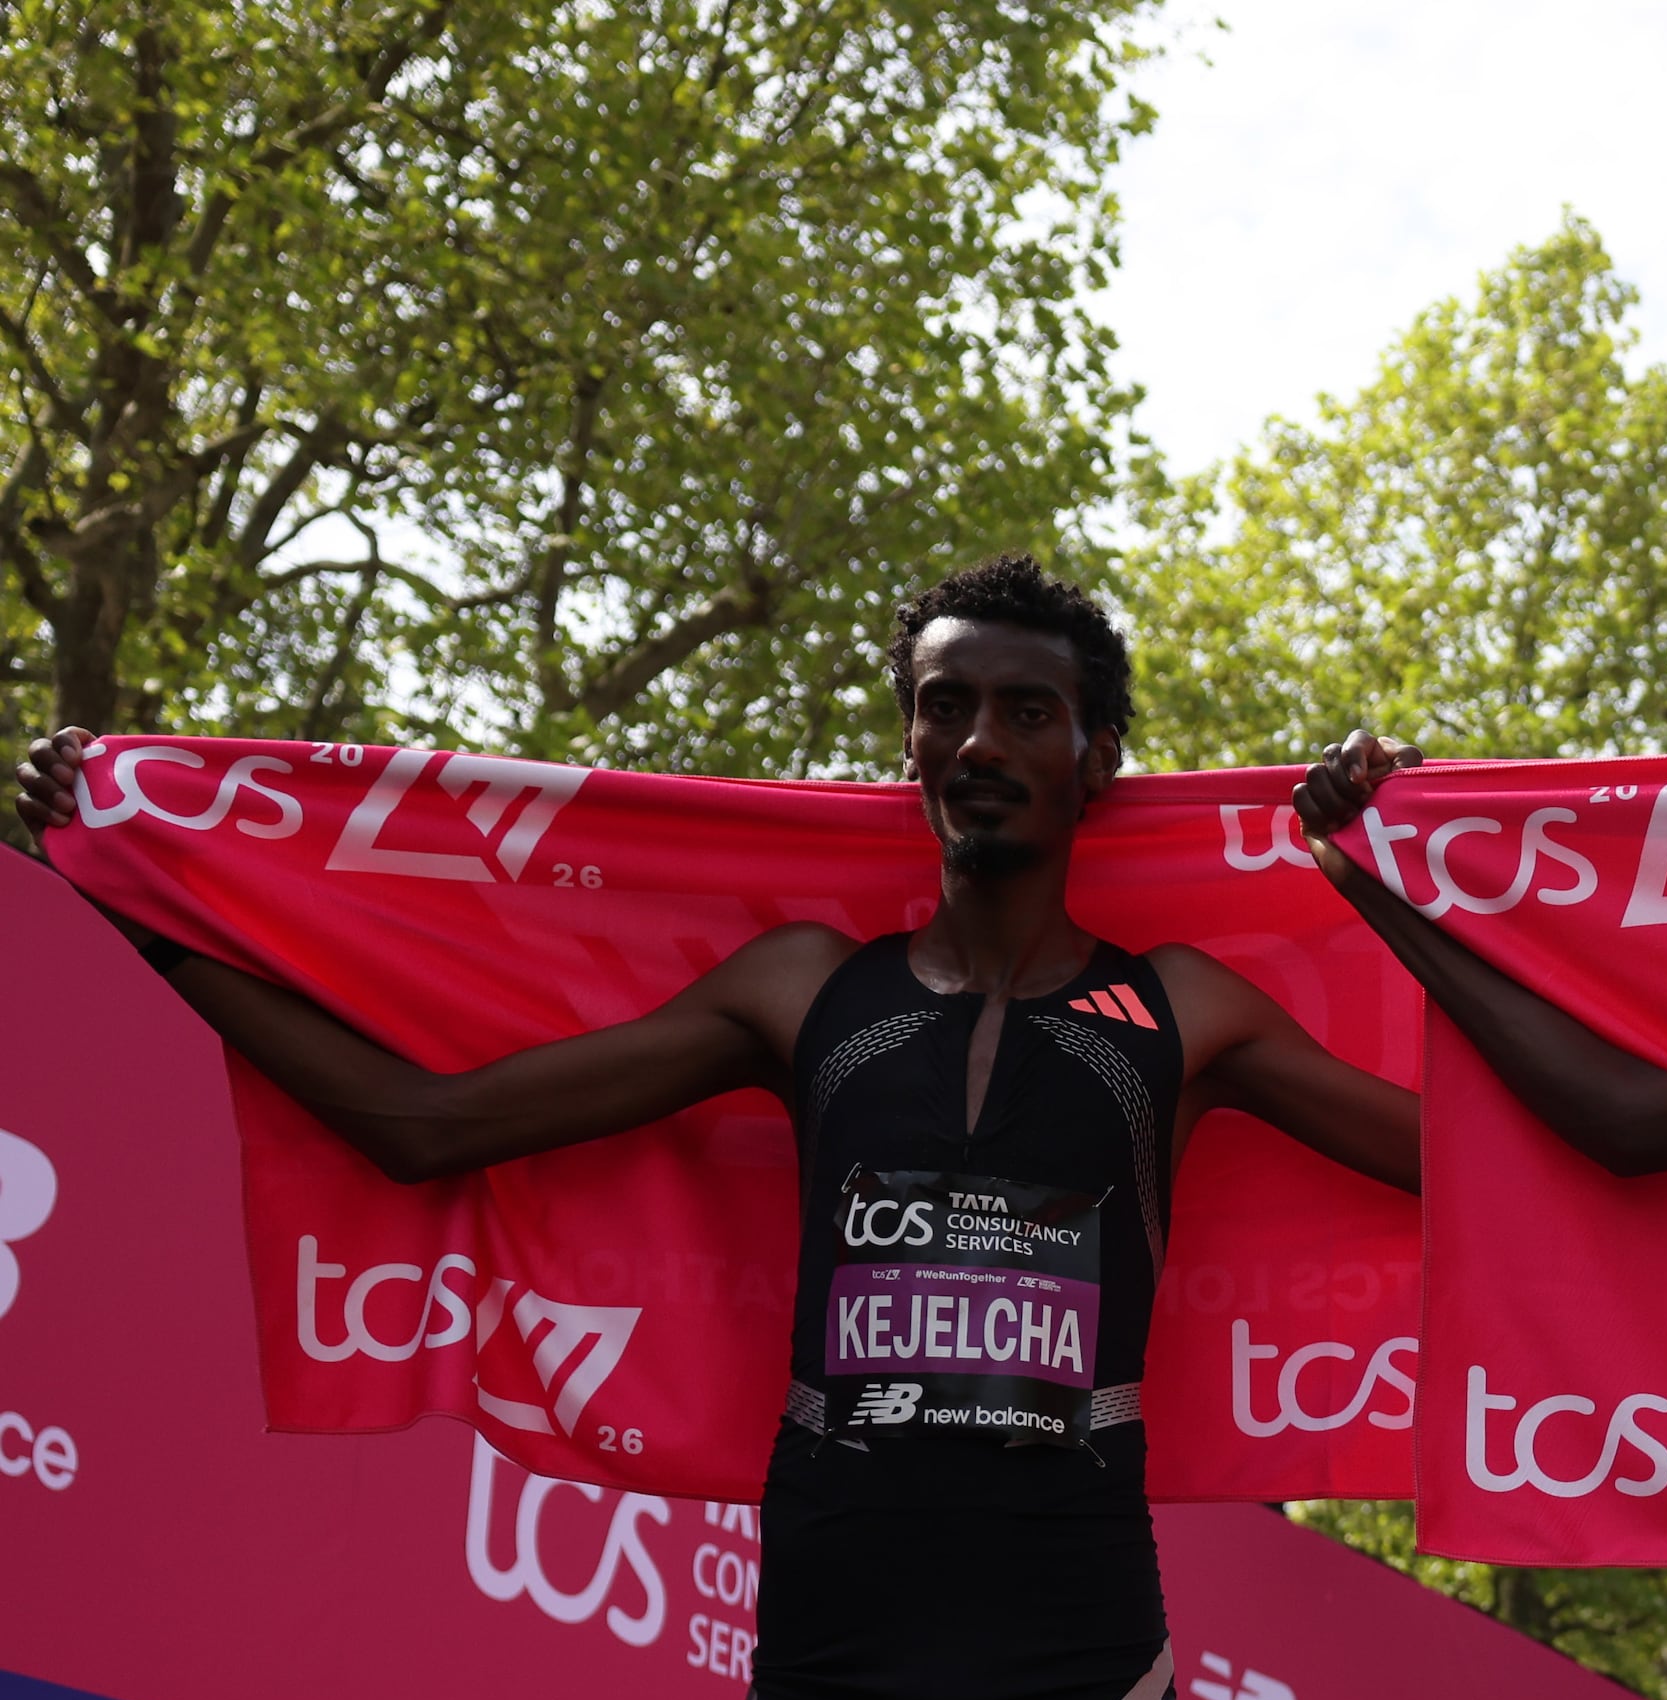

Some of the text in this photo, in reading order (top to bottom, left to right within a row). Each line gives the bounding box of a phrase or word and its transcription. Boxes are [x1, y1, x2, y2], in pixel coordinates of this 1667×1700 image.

[73, 743, 304, 841] tcs
[551, 862, 605, 891] 26
[1361, 804, 1600, 922] tcs
[843, 1191, 935, 1248] tcs
[946, 1212, 1082, 1247] CONSULTANCY
[948, 1191, 1009, 1214] TATA
[914, 1269, 1007, 1284] #WeRunTogether
[945, 1233, 1034, 1256] SERVICES
[296, 1234, 478, 1363] tcs
[596, 1424, 645, 1456] 26
[838, 1294, 1084, 1375] KEJELCHA
[1231, 1317, 1419, 1439] tcs
[923, 1406, 970, 1425] new
[975, 1406, 1066, 1435] balance
[464, 1428, 672, 1647] tcs
